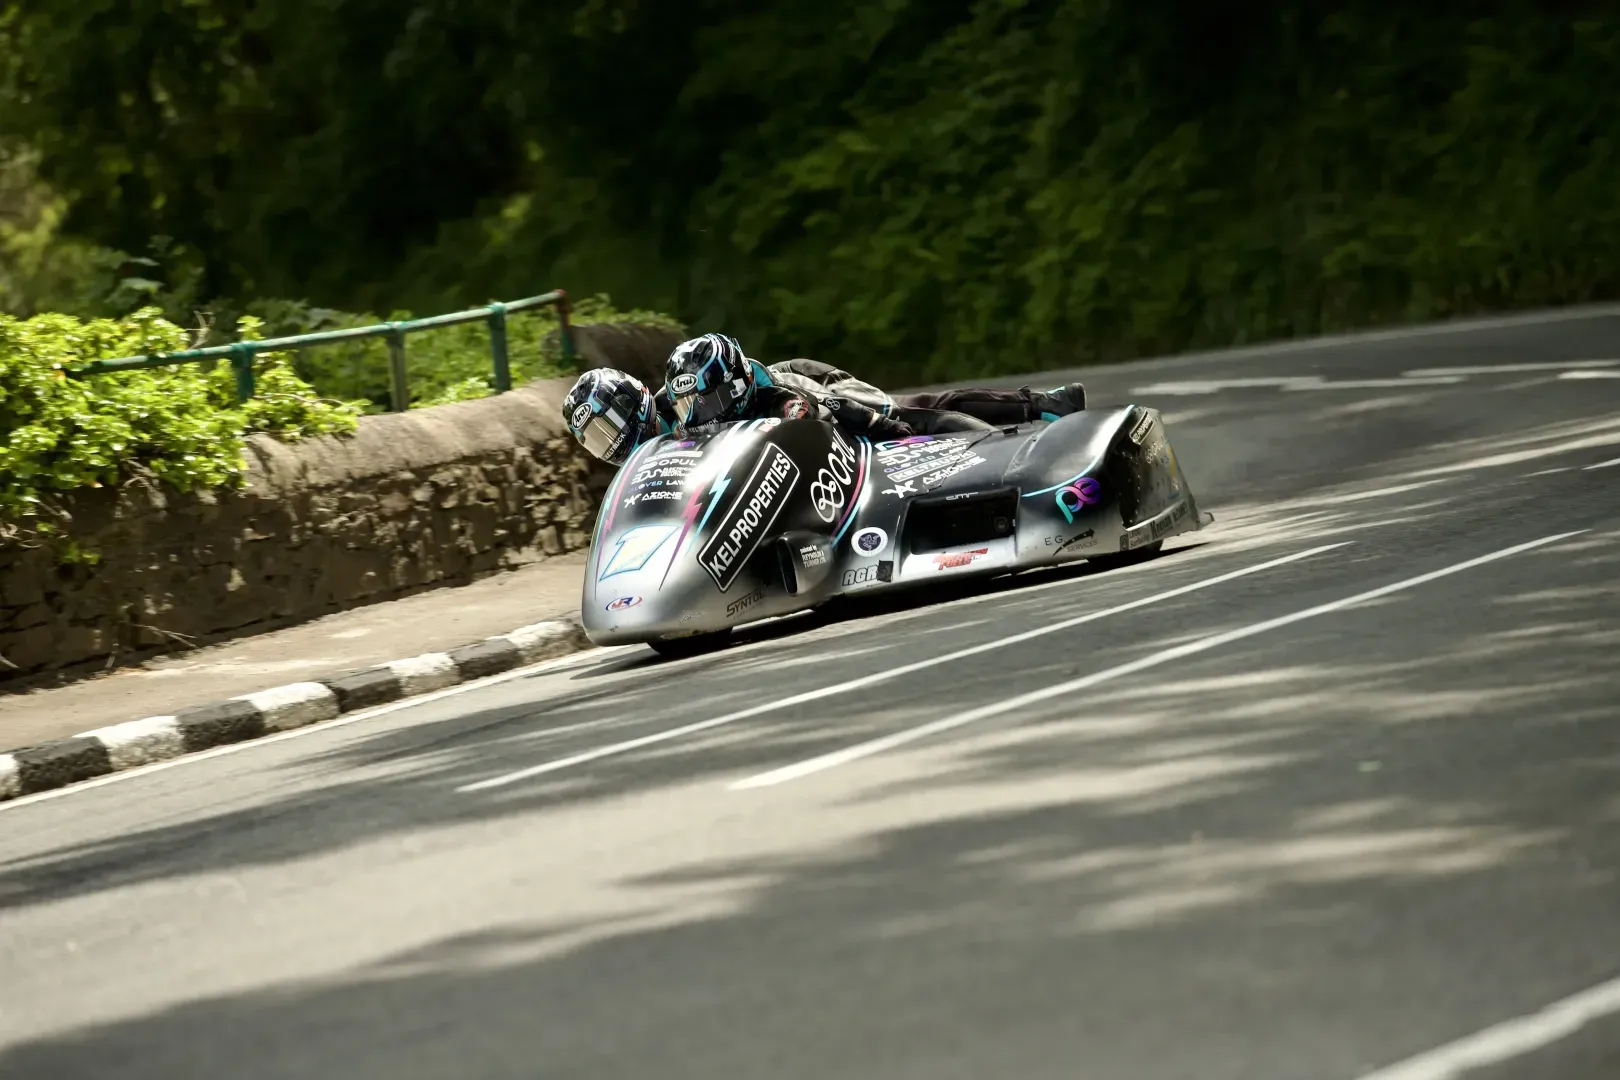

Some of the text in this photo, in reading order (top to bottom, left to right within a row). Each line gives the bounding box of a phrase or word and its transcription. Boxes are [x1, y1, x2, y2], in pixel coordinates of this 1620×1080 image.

[672, 378, 694, 388] Arai
[573, 405, 590, 424] Arai
[709, 453, 791, 577] KELPROPERTIES
